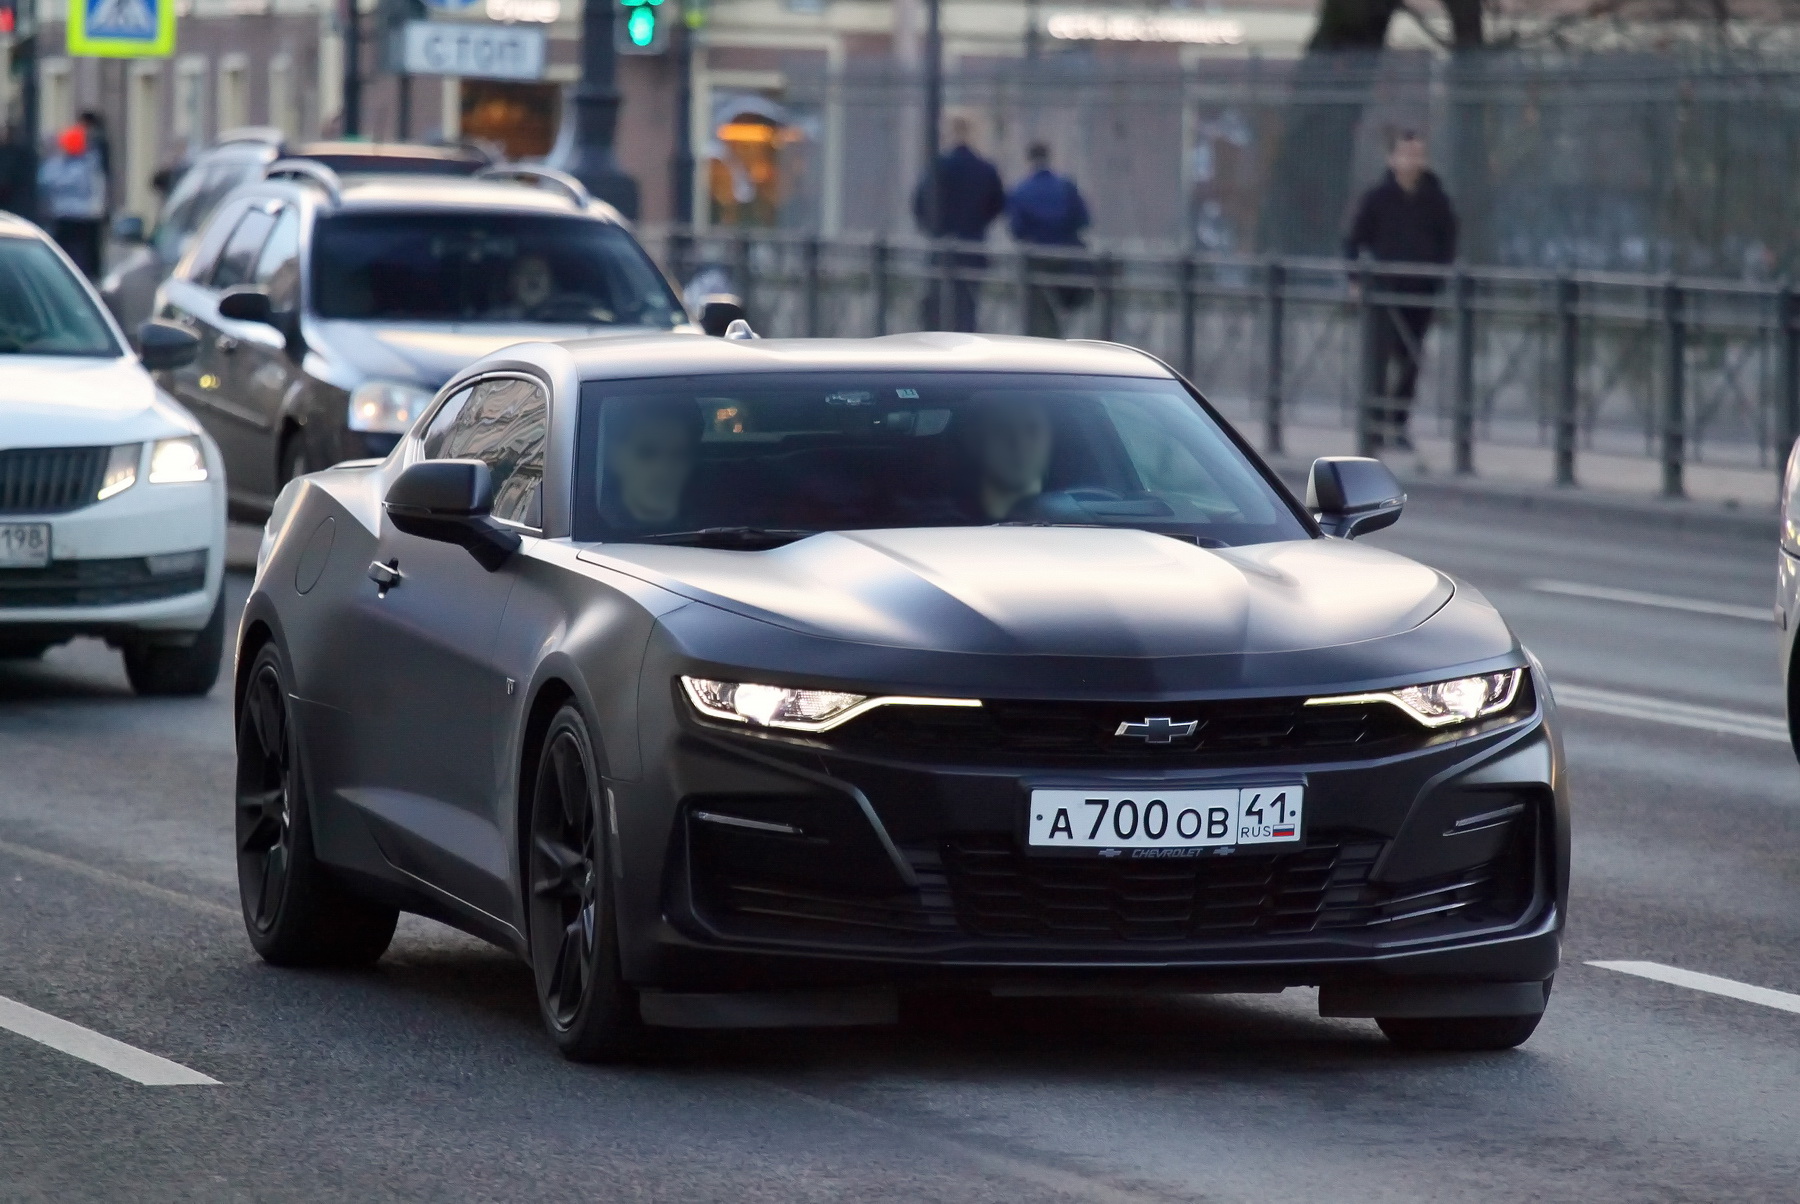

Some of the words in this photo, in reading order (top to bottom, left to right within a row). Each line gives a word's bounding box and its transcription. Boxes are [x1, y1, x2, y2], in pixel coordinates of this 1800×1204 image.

[421, 33, 528, 70] СТОП
[1048, 798, 1230, 840] А700ОВ
[1245, 792, 1286, 825] 41
[1240, 825, 1271, 839] RUS
[1131, 847, 1204, 858] CHEVROLET
